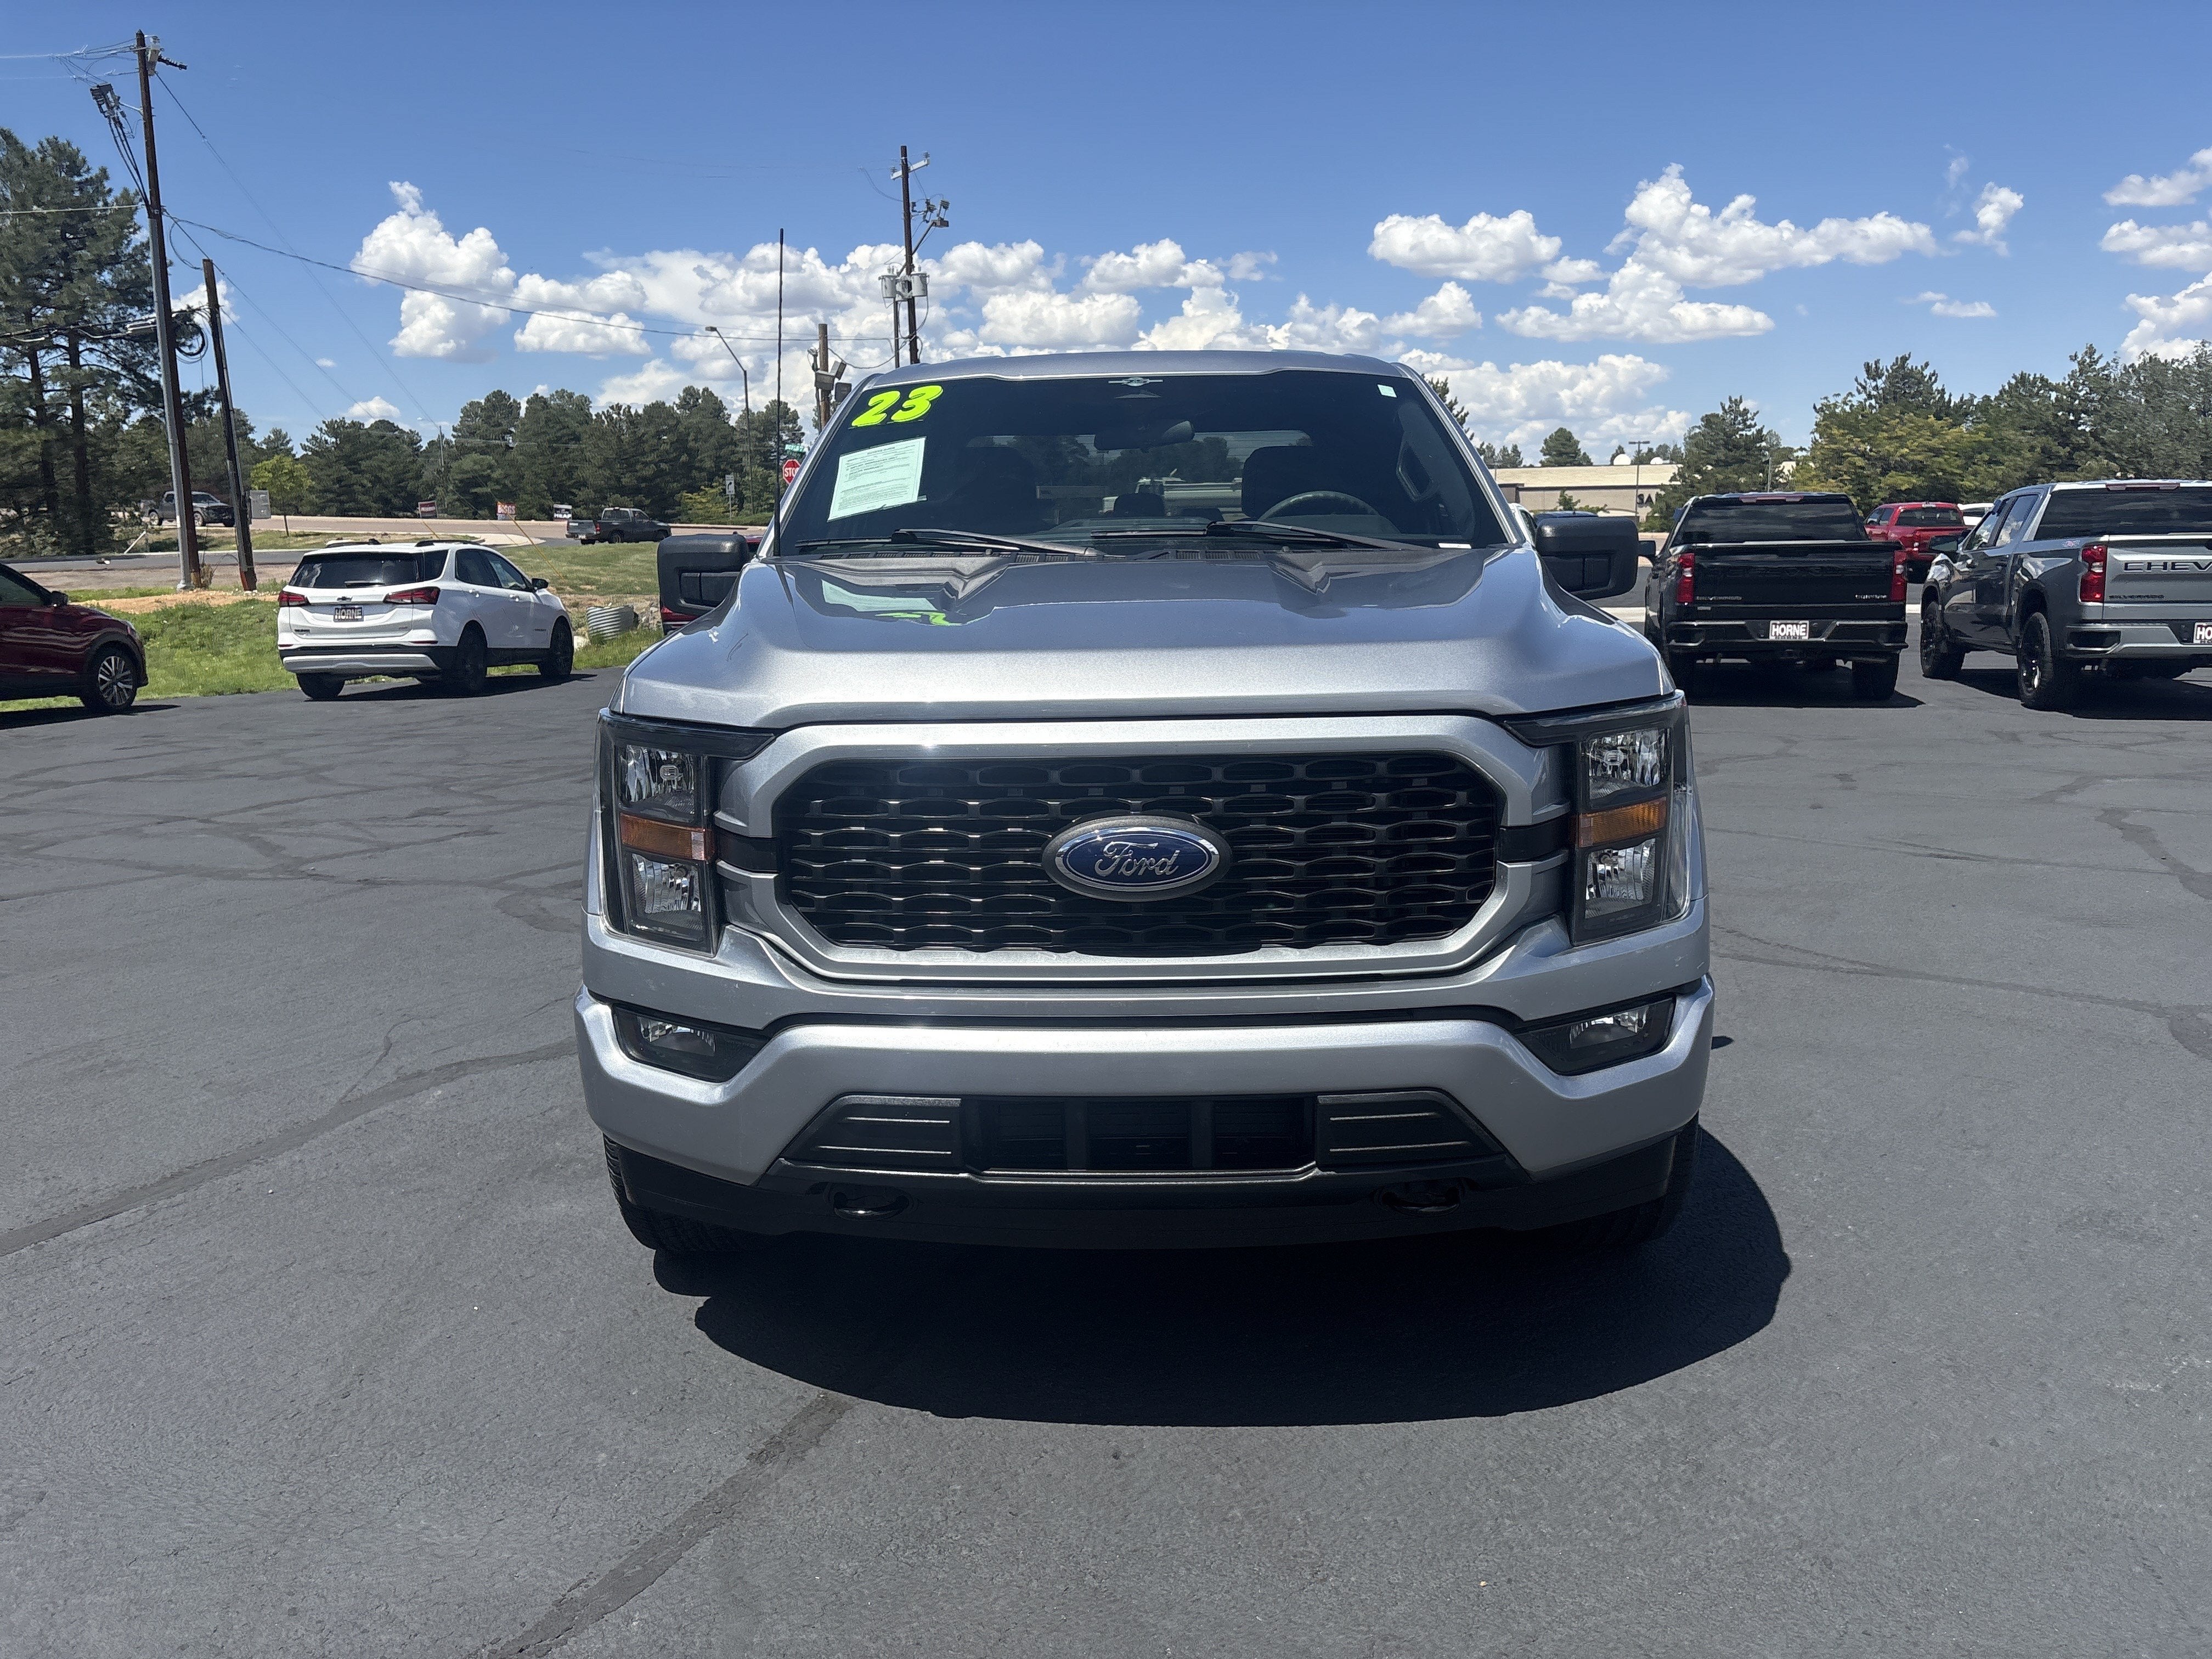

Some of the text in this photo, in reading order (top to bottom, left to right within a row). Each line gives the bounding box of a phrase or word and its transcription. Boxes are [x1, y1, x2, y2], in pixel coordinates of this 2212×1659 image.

[851, 385, 944, 427] 23
[784, 467, 800, 477] STO
[2124, 562, 2212, 572] CHEV
[335, 609, 362, 619] HORNE
[1771, 624, 1807, 636] HORNE
[2196, 627, 2212, 640] HO
[1094, 841, 1180, 877] Ford
